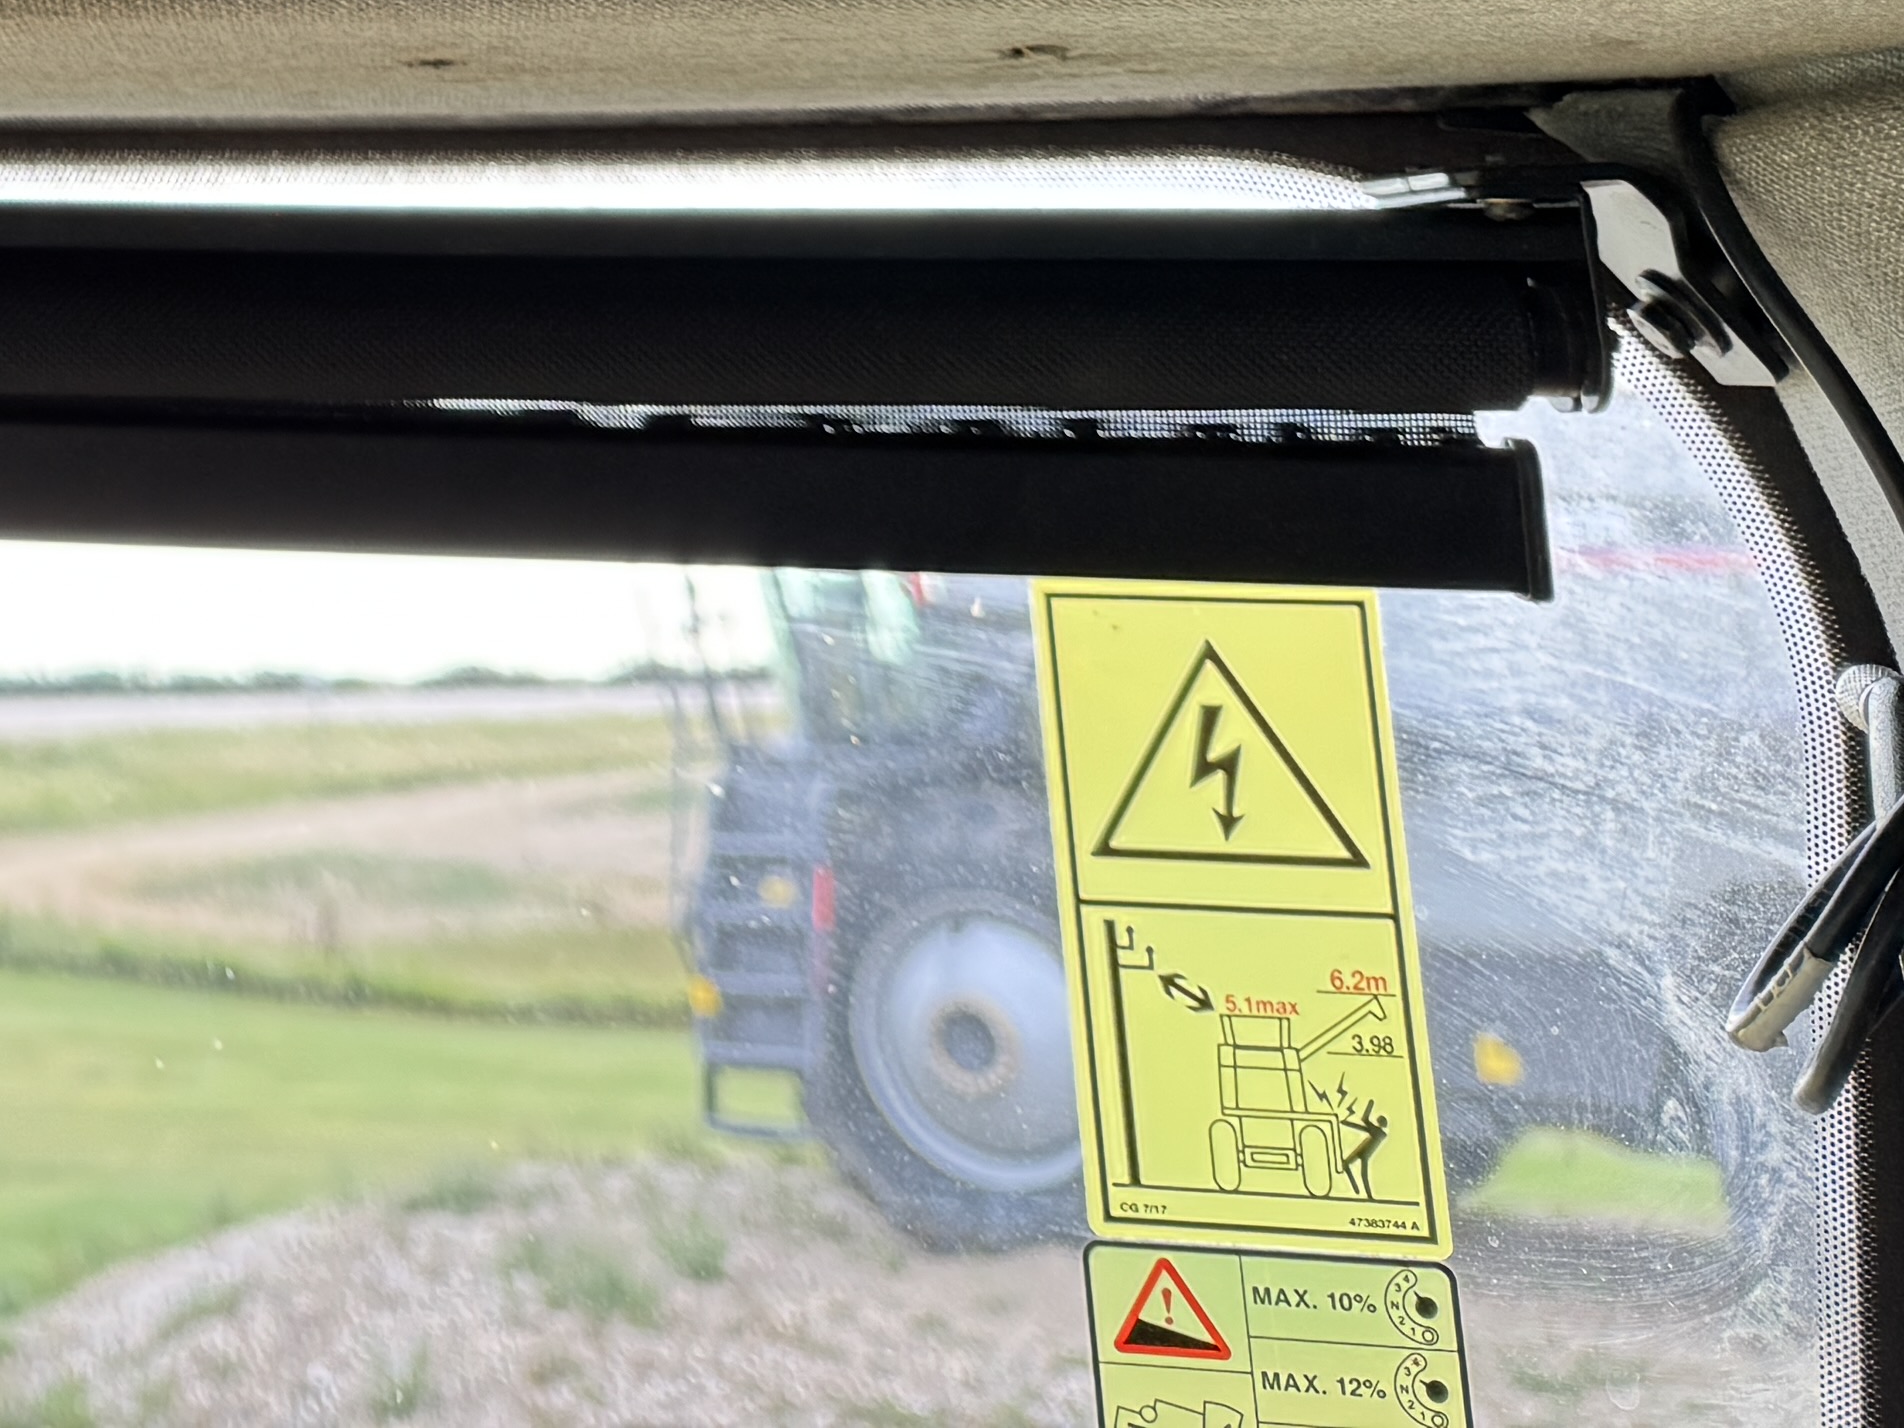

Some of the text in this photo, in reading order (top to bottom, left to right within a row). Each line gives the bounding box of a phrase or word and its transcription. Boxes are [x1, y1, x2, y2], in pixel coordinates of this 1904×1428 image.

[1329, 968, 1388, 992] 6.2m
[1224, 994, 1300, 1015] 5.1max
[1351, 1034, 1395, 1055] 3.98
[1411, 1221, 1421, 1231] A
[1252, 1286, 1378, 1314] MAX. 10%
[1261, 1371, 1388, 1400] MAX. 12%
